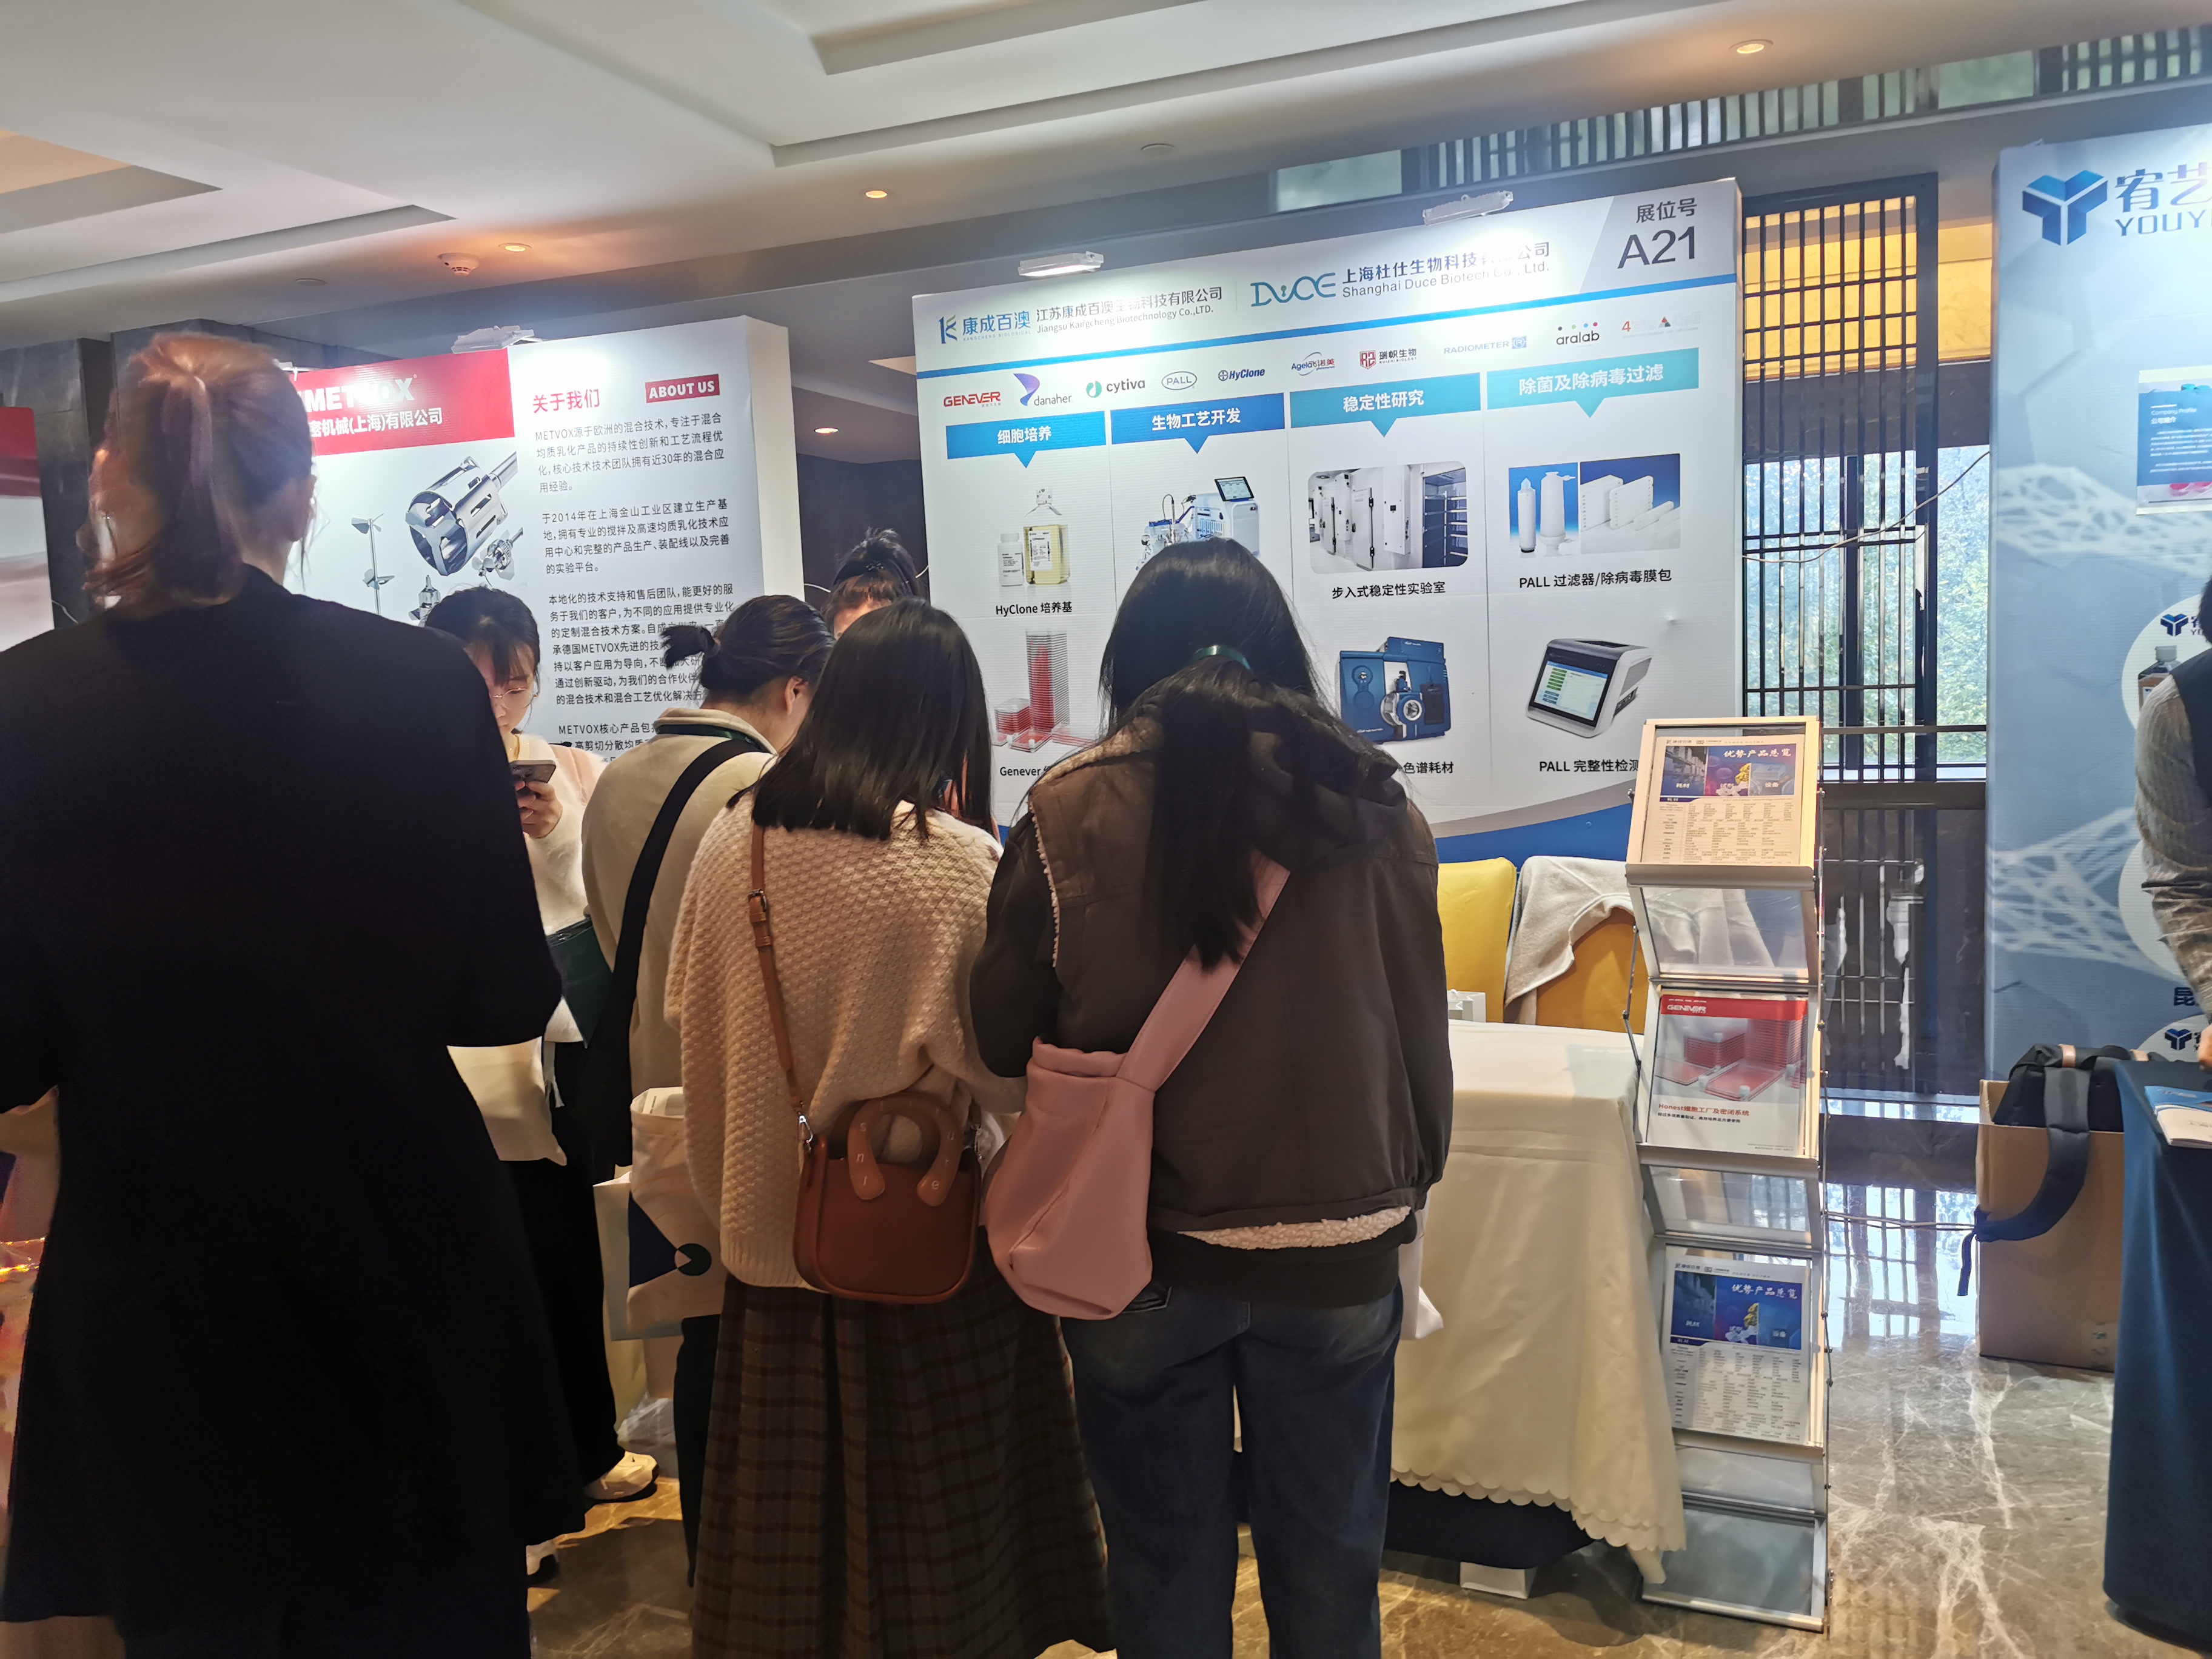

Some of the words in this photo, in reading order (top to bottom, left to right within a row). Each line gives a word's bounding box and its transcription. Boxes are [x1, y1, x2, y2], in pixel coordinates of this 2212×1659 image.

[1636, 197, 1697, 223] 展位号
[2115, 210, 2212, 236] YOUY
[1617, 226, 1695, 269] A21
[1342, 280, 1401, 298] Shanghai
[1405, 277, 1437, 290] Duce
[1441, 269, 1490, 285] Biotech
[1524, 260, 1550, 273] Ltd.
[1036, 286, 1222, 322] 江苏康成百澳生物科技有限公司
[962, 310, 1031, 335] 康成百澳
[1037, 321, 1068, 334] Jiangsu
[1070, 315, 1115, 331] Kangcheng
[1117, 309, 1178, 325] Biotechnology
[1444, 340, 1509, 355] RADIOMETER
[1555, 330, 1600, 346] aralab
[1166, 376, 1192, 386] PALL
[1228, 367, 1265, 381] HyClone
[1518, 363, 1664, 396] 除菌及除病毒过滤
[305, 377, 415, 412] METOX
[649, 383, 695, 399] ABOUT
[697, 380, 715, 394] US
[1106, 379, 1145, 393] cytiva
[532, 389, 600, 414] 关于我们
[943, 391, 1001, 407] GENEVER
[1342, 389, 1424, 414] 稳定性研究
[1152, 407, 1241, 431] 生物工艺开发
[536, 430, 723, 458] 均质乳化产品的持续性创新和工艺流程优
[997, 426, 1052, 446] 细胞培养
[539, 480, 573, 494] 用经验。
[542, 498, 728, 524] 于2014年在上海金山工业区建立生产基
[546, 561, 598, 574] 的实验平台。
[1519, 576, 1550, 589] PALL
[1553, 568, 1672, 588] 过滤器/除病毒膜包
[1332, 580, 1446, 600] 步入式稳定性实验室
[996, 603, 1038, 617] HyClone
[1041, 601, 1073, 614] 培养基
[999, 766, 1041, 777] Genever
[1539, 760, 1570, 773] PALL
